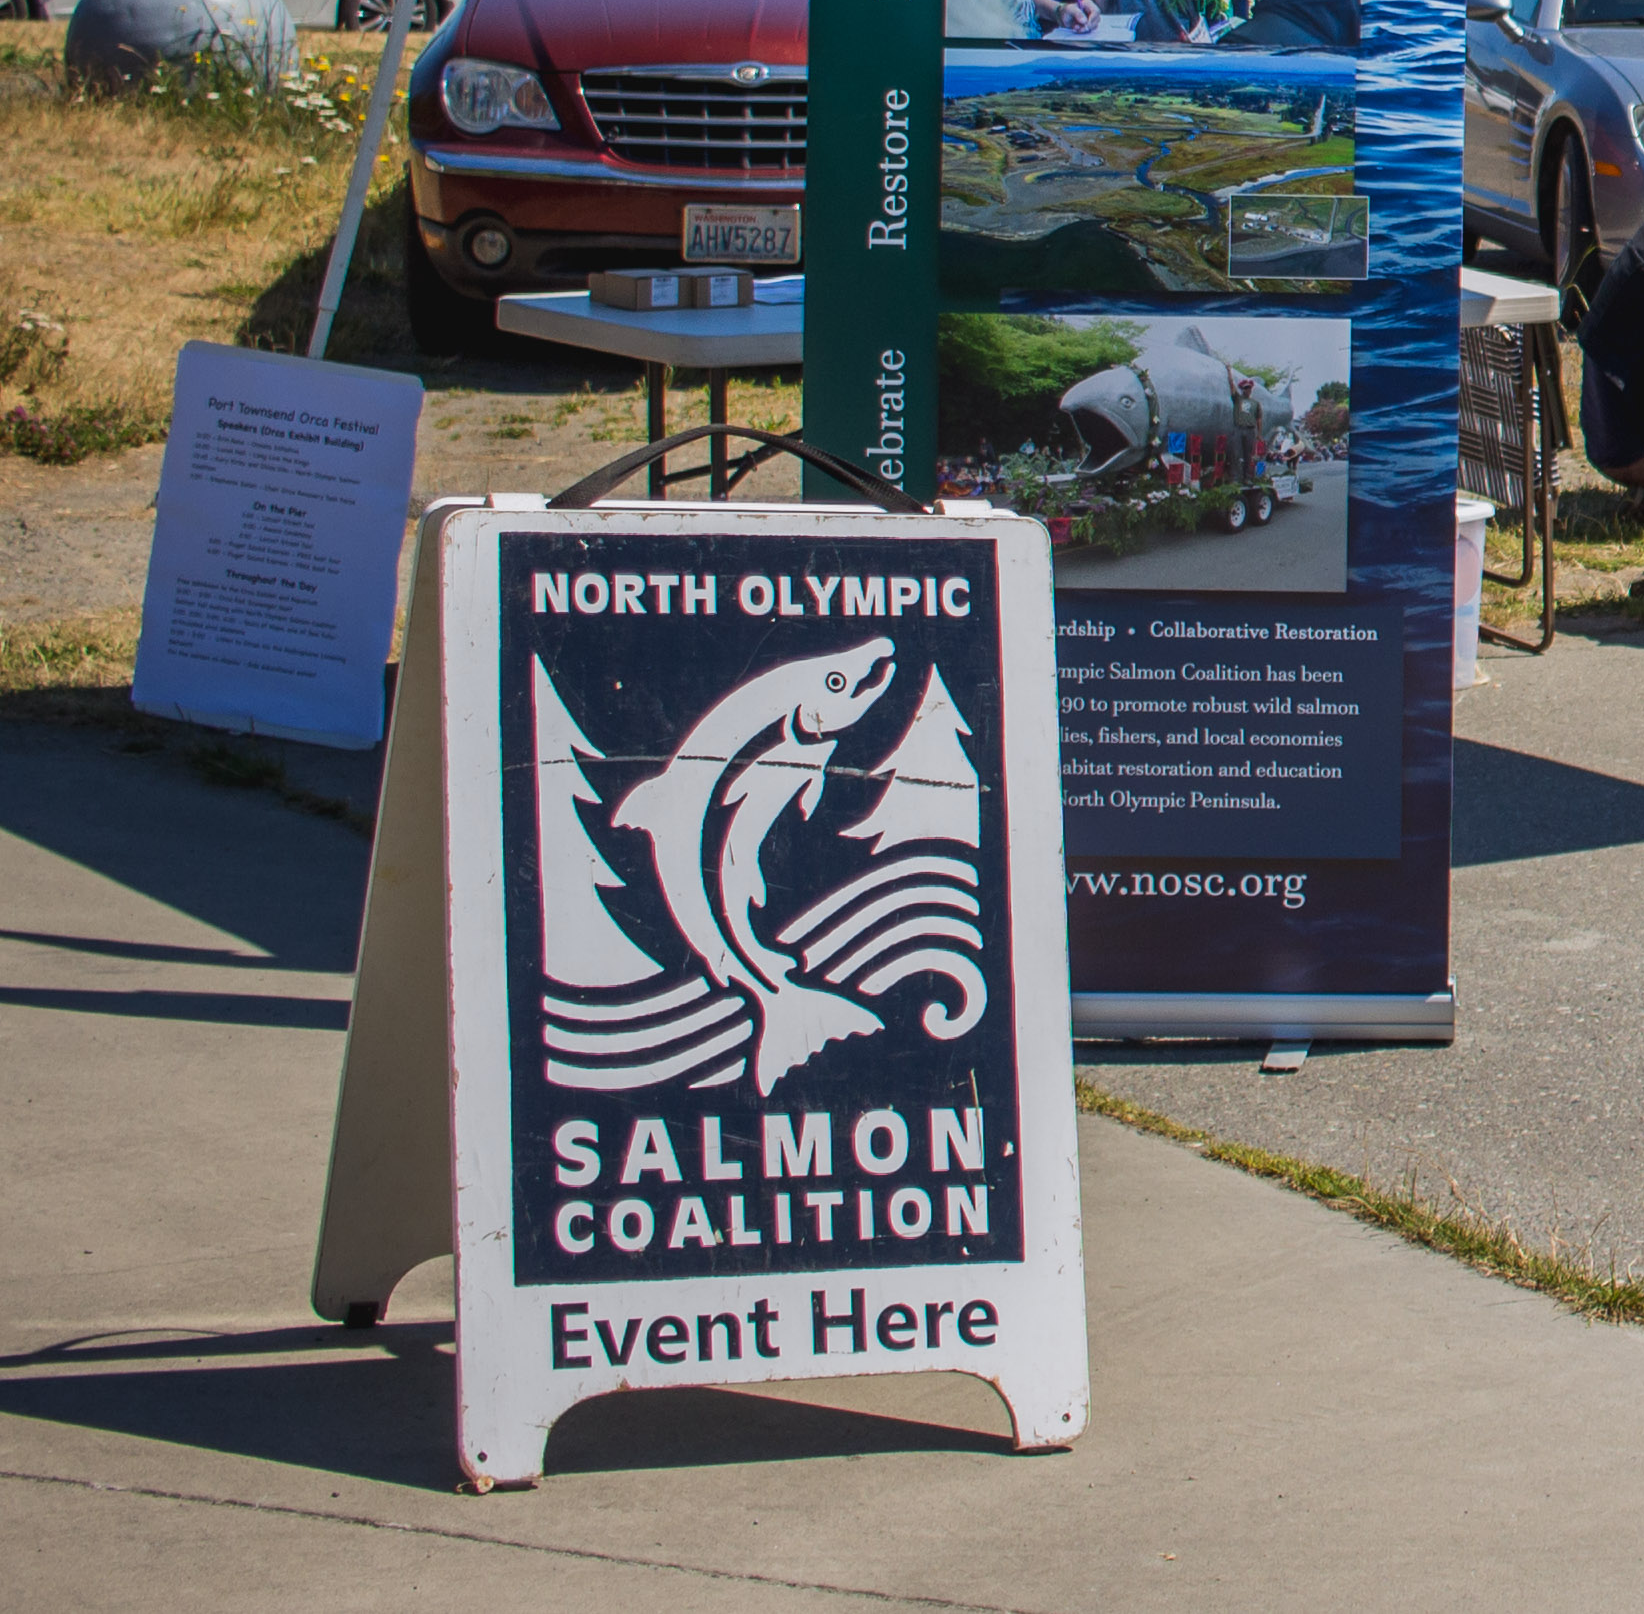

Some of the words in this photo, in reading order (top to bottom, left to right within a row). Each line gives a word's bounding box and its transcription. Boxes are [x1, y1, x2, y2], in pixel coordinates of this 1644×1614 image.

[869, 88, 910, 250] Restore
[692, 225, 791, 254] AHV5287
[208, 397, 234, 411] Port
[239, 402, 296, 422] Townsend
[299, 412, 328, 427] Orca
[333, 417, 380, 435] Festival
[866, 349, 906, 492] ebrate
[531, 572, 718, 615] NORTH
[740, 574, 972, 617] OLYMPIC
[1056, 620, 1116, 642] rdship
[1150, 620, 1269, 639] Collaborative
[1275, 622, 1378, 641] Restoration
[1057, 662, 1105, 684] mpic
[1109, 661, 1176, 680] Salmon
[1181, 663, 1262, 682] Coalition
[1266, 664, 1296, 682] has
[1300, 665, 1344, 683] been
[1059, 697, 1086, 714] 90
[1090, 698, 1108, 712] to
[1112, 700, 1188, 717] promote
[1192, 695, 1249, 713] robust
[1253, 696, 1292, 714] wild
[1297, 697, 1360, 715] salmon
[1098, 726, 1162, 747] fishers,
[1166, 728, 1199, 745] and
[1204, 728, 1246, 745] local
[1250, 730, 1343, 747] economies
[1061, 758, 1114, 776] abitat
[1118, 760, 1213, 777] restoration
[1218, 760, 1251, 778] and
[1256, 761, 1343, 779] education
[1110, 790, 1186, 813] Olympic
[1190, 791, 1281, 810] Peninsula.
[553, 1108, 986, 1185] SALMON
[555, 1185, 991, 1253] COALITION
[549, 1294, 781, 1371] Event
[812, 1286, 999, 1358] Here
